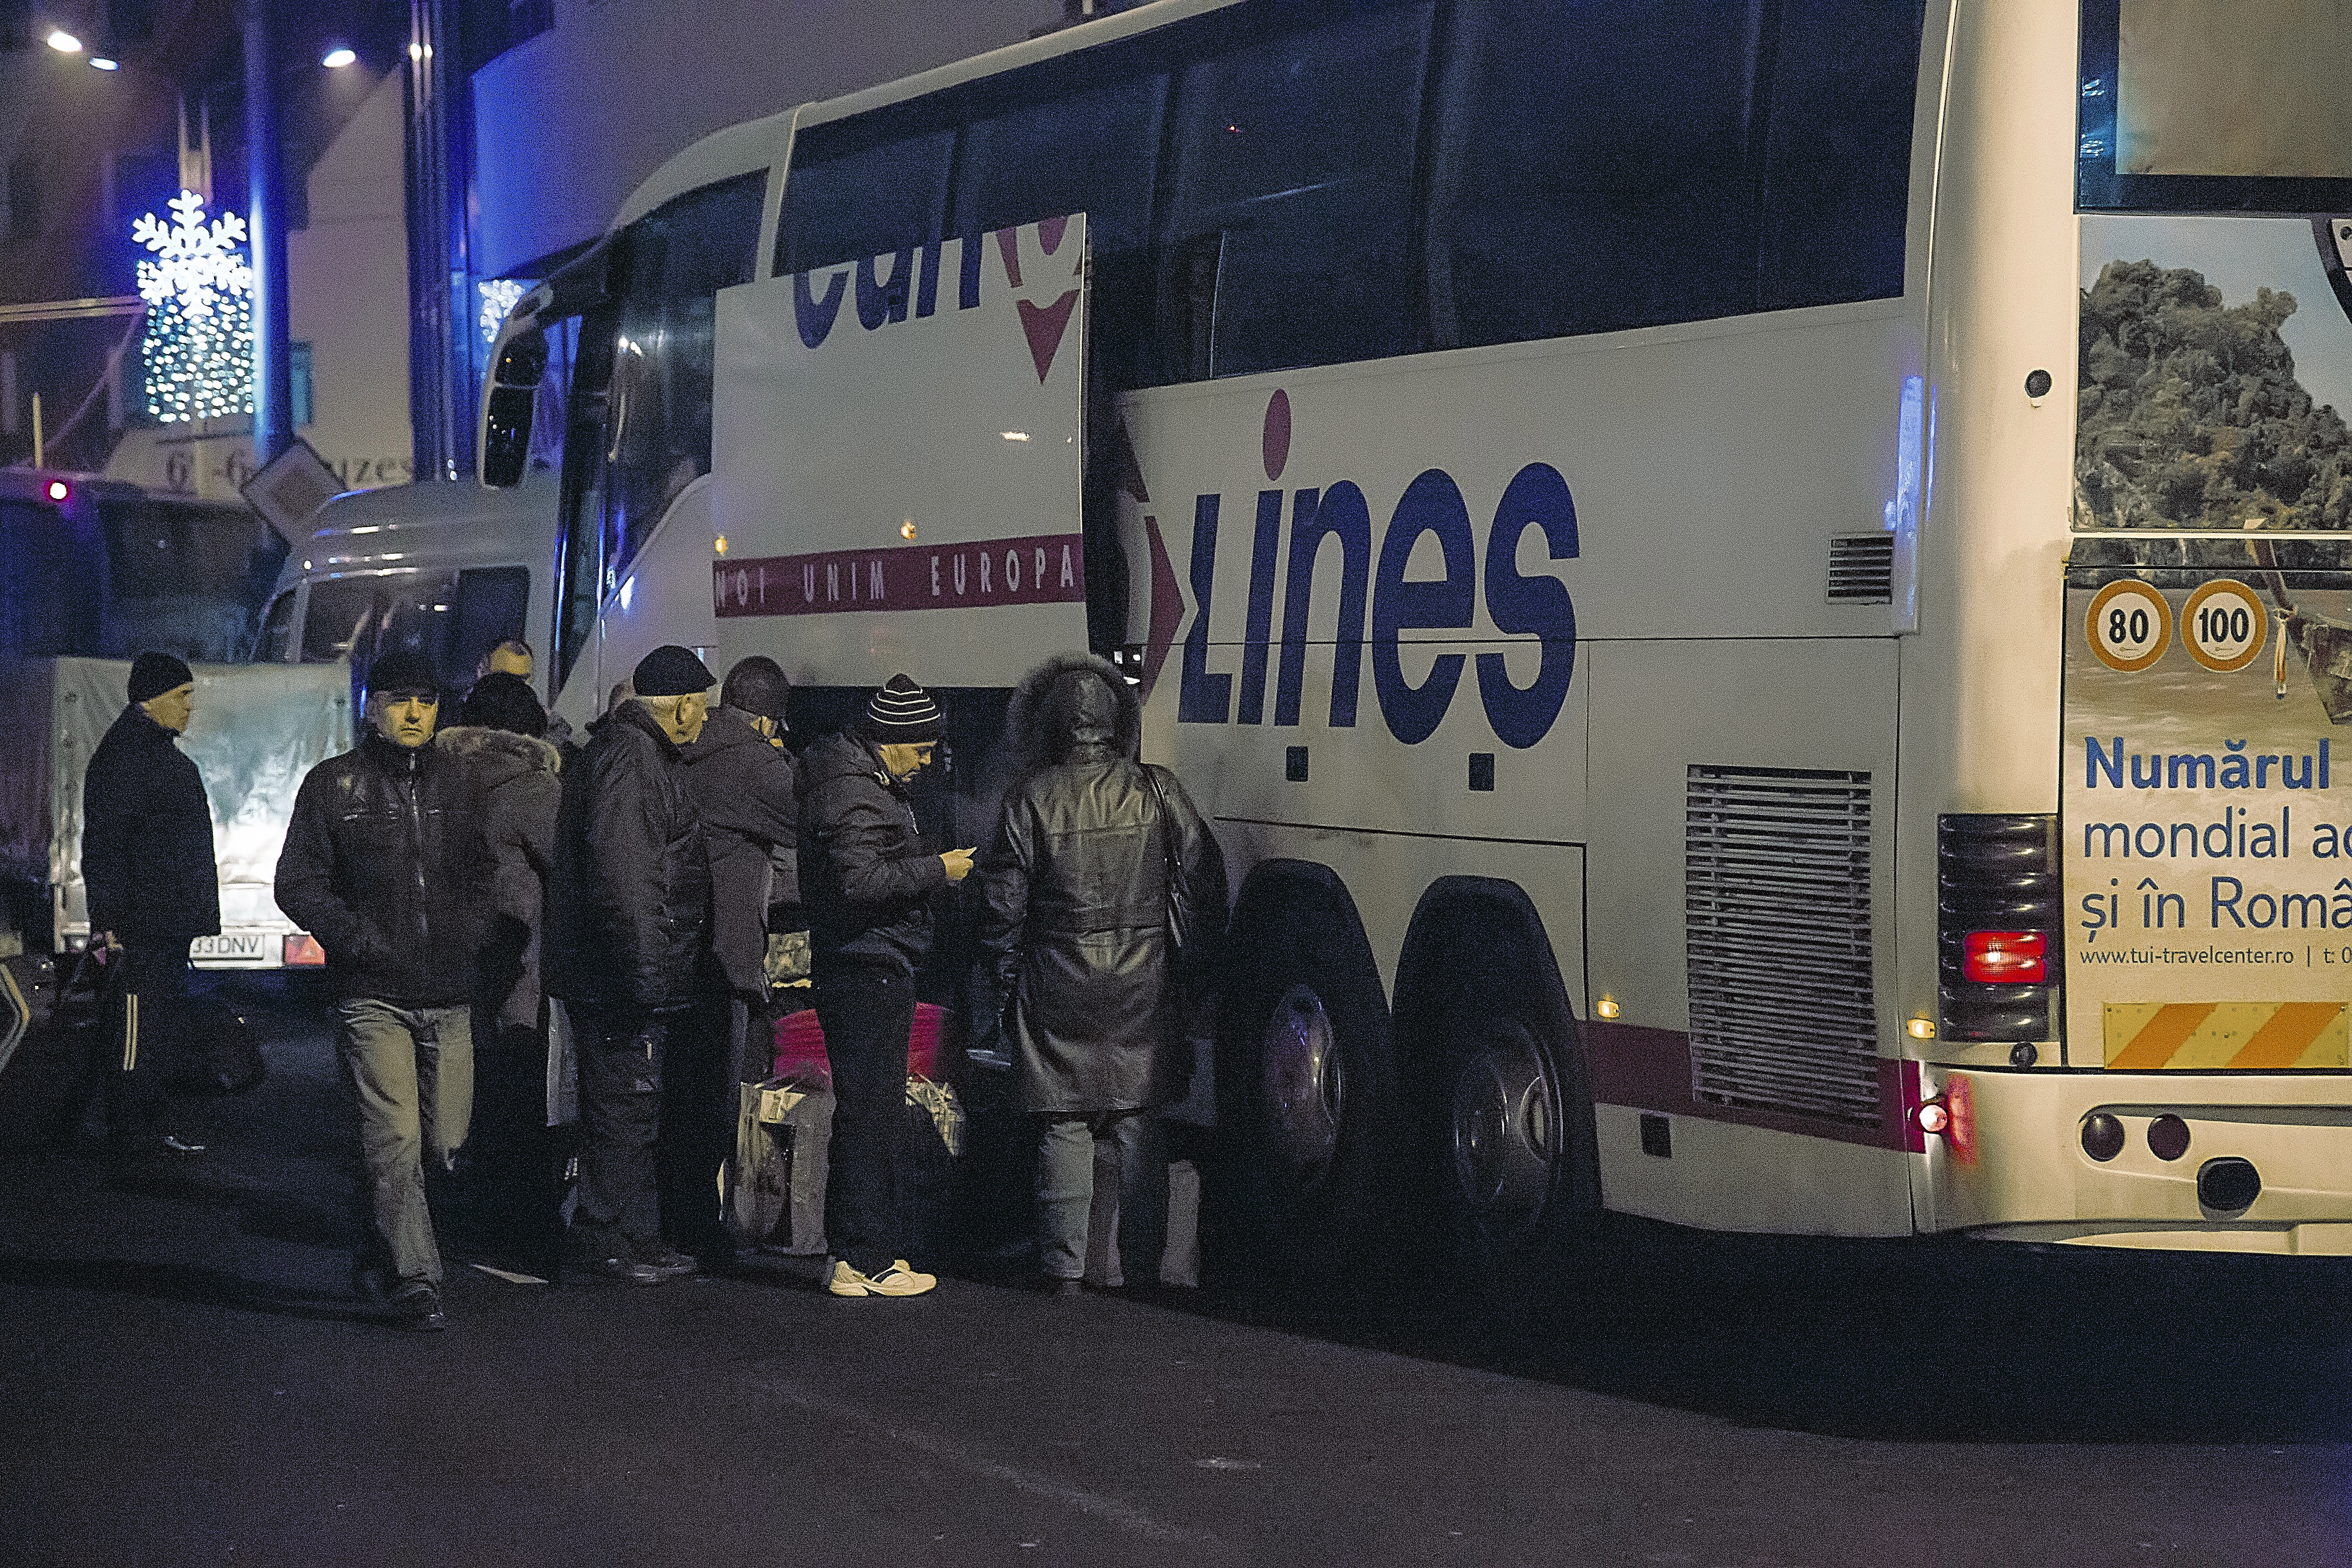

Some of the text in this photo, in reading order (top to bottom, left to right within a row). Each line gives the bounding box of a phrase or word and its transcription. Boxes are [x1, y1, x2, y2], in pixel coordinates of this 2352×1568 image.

[715, 544, 1074, 607] NOI UNIM EUROPA
[2109, 608, 2149, 644] 80
[2198, 608, 2249, 644] 100
[2085, 736, 2329, 789] Numărul
[2084, 806, 2290, 858] mondial
[2081, 878, 2119, 943] și
[2136, 877, 2185, 929] în
[218, 936, 259, 953] DNV
[2080, 946, 2294, 964] www.tui-travelcenter.ro
